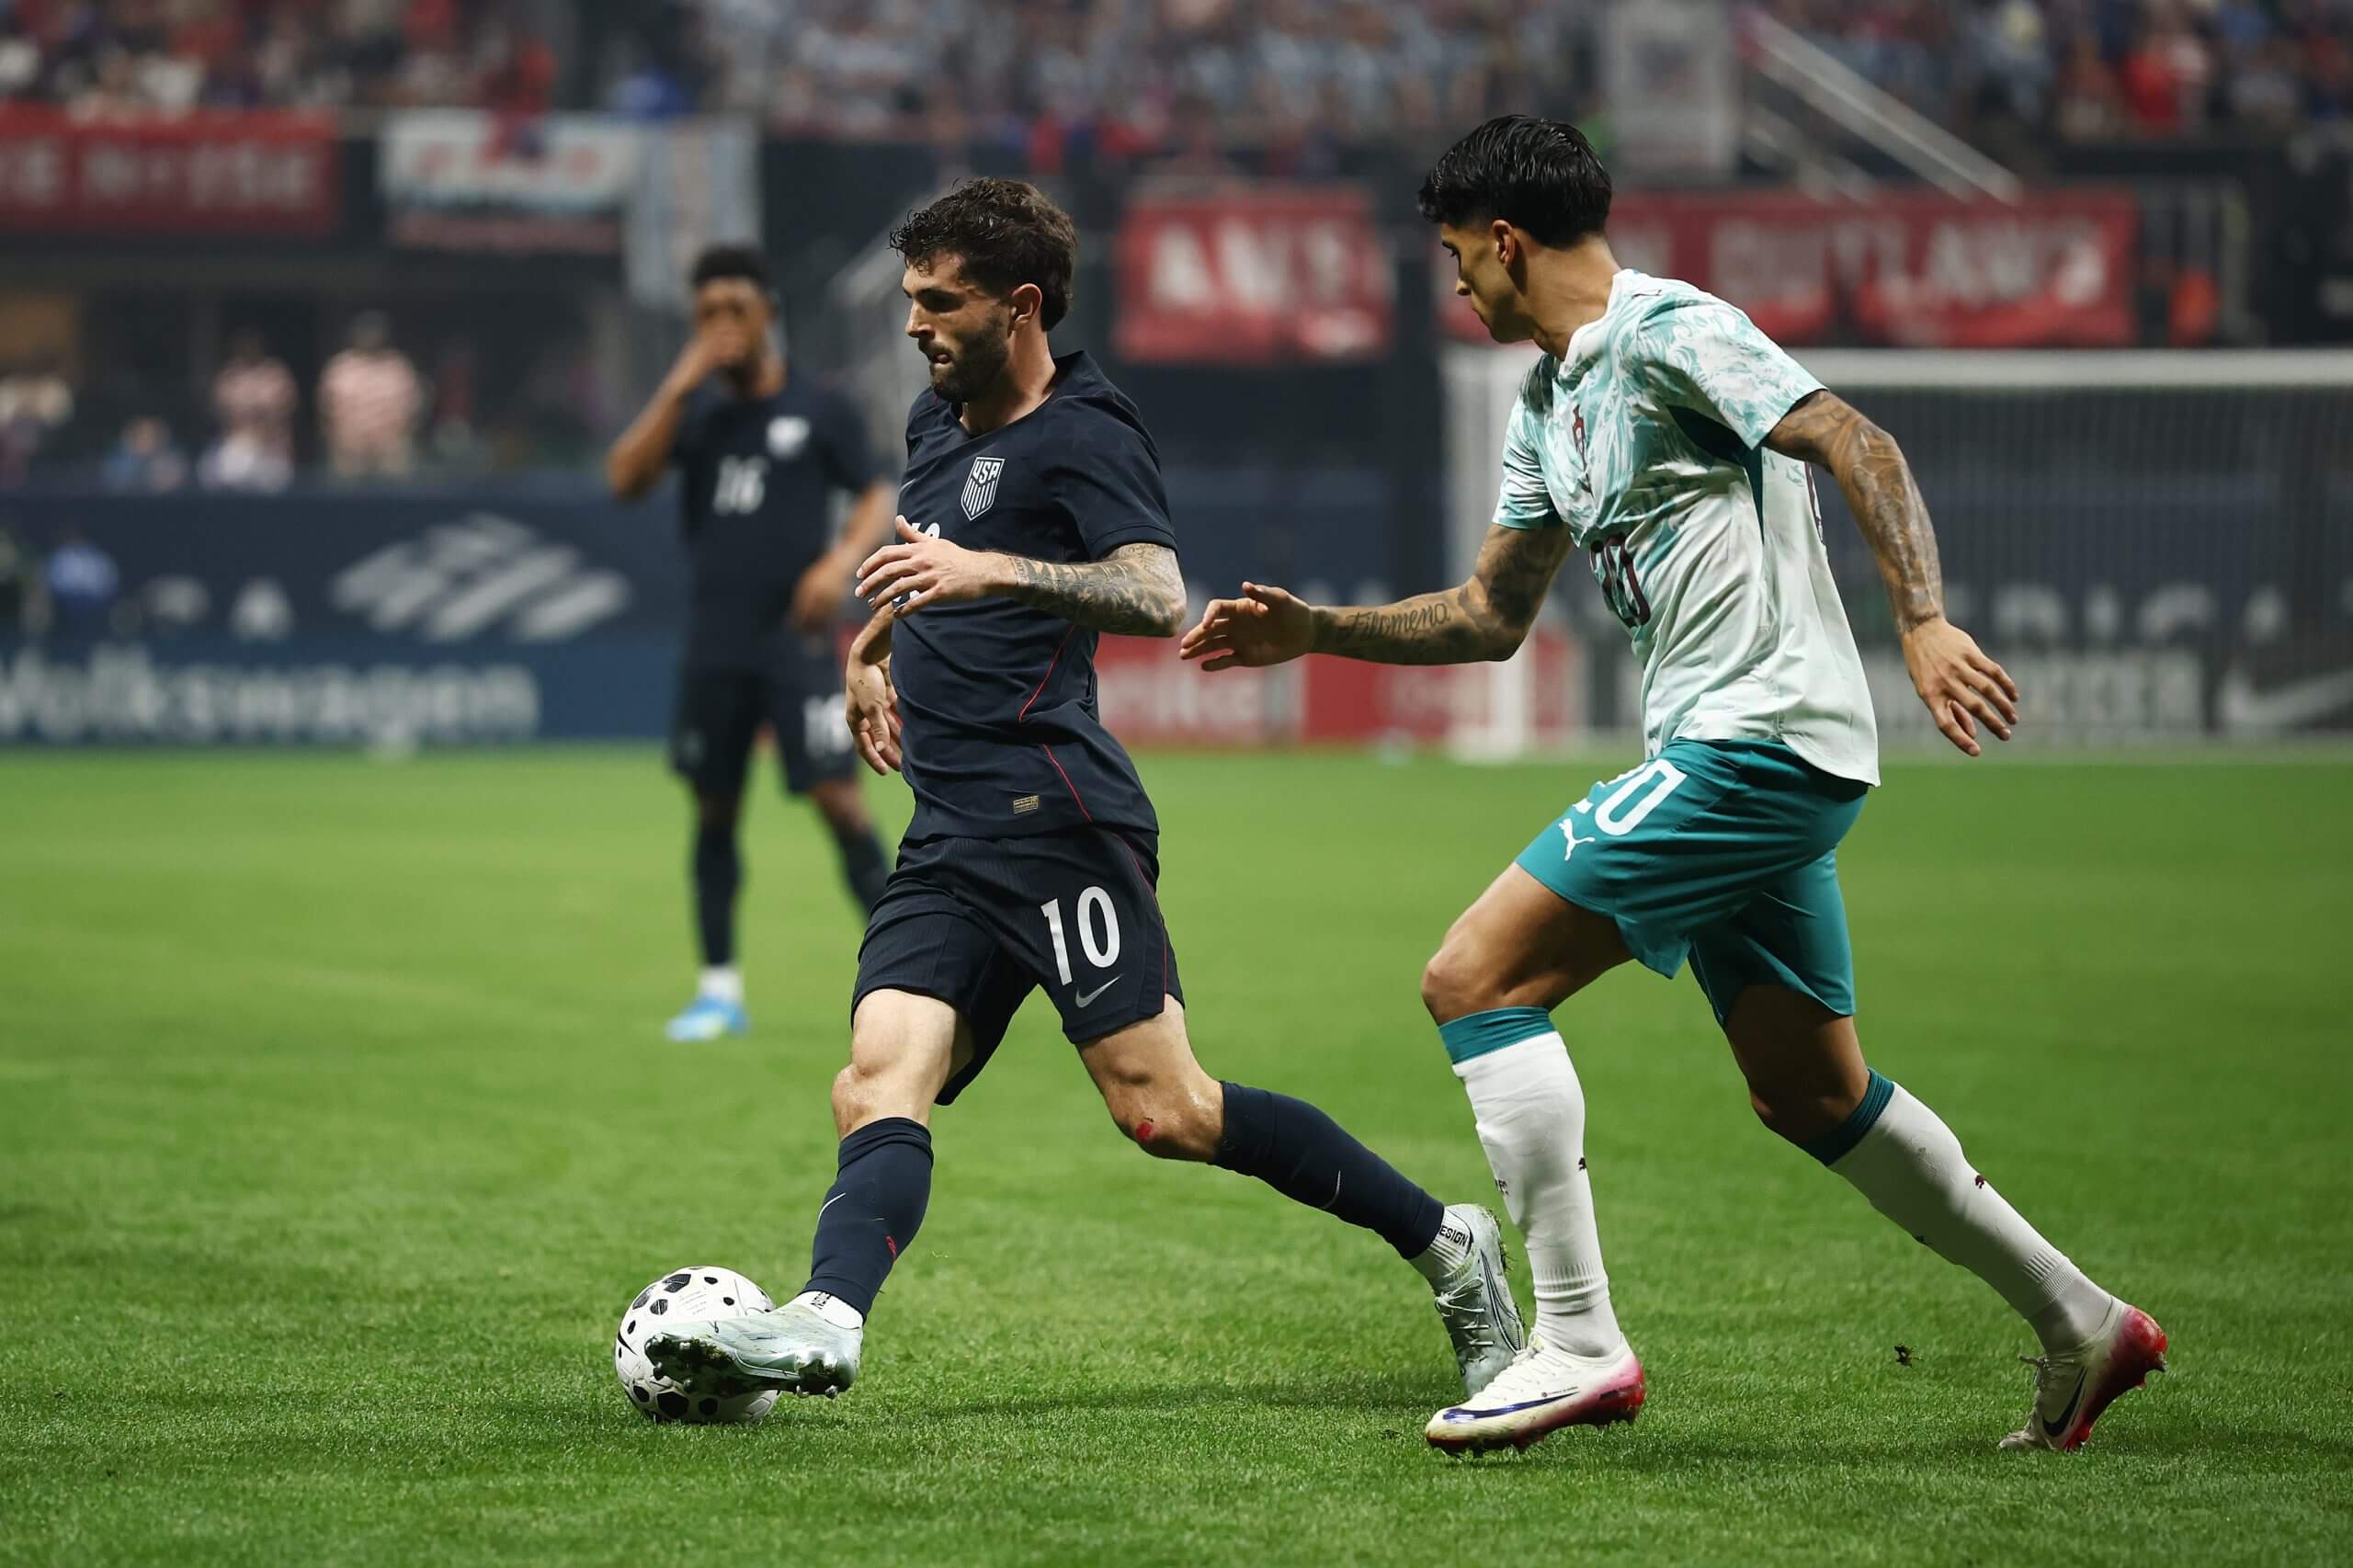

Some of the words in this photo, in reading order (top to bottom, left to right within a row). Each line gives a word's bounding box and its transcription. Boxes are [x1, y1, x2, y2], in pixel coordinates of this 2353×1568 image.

[712, 454, 770, 517] 16
[971, 460, 1001, 484] USA
[1040, 886, 1120, 986] 10
[1438, 1224, 1469, 1247] ESIGN
